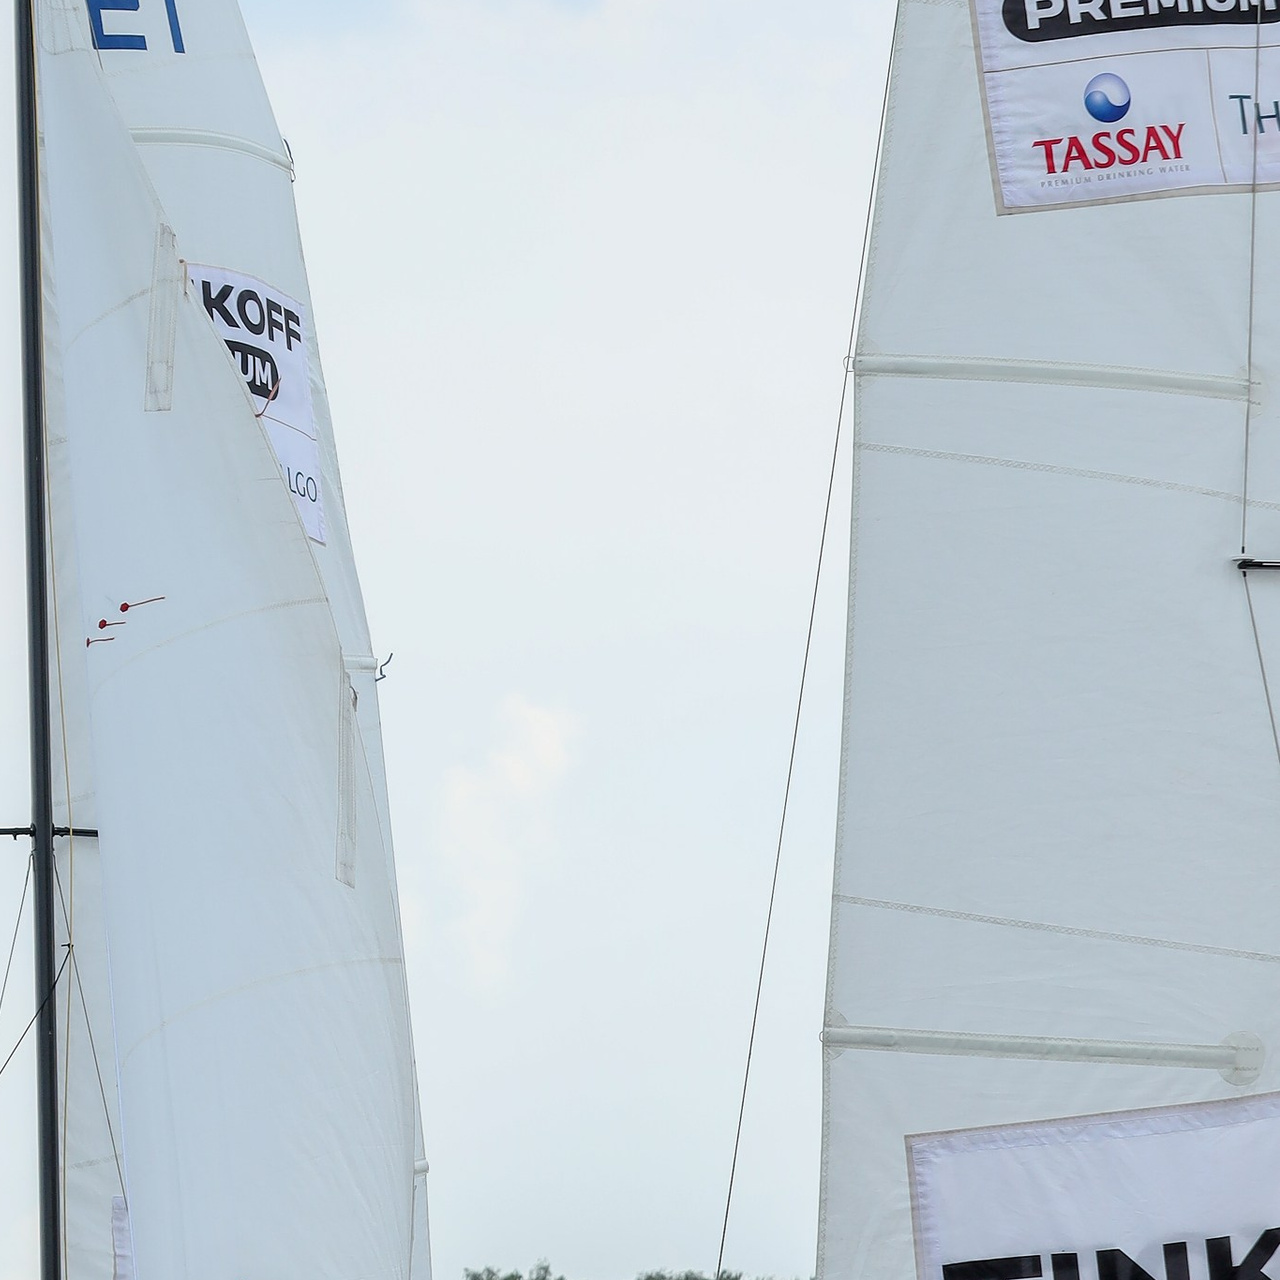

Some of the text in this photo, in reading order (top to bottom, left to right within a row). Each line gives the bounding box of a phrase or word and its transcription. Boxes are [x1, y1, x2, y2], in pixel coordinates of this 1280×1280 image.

[1031, 122, 1186, 176] TASSAY
[1040, 164, 1191, 188] PREMIUM DRINKING WATER
[201, 280, 302, 352] KOFF
[286, 466, 318, 503] LGO
